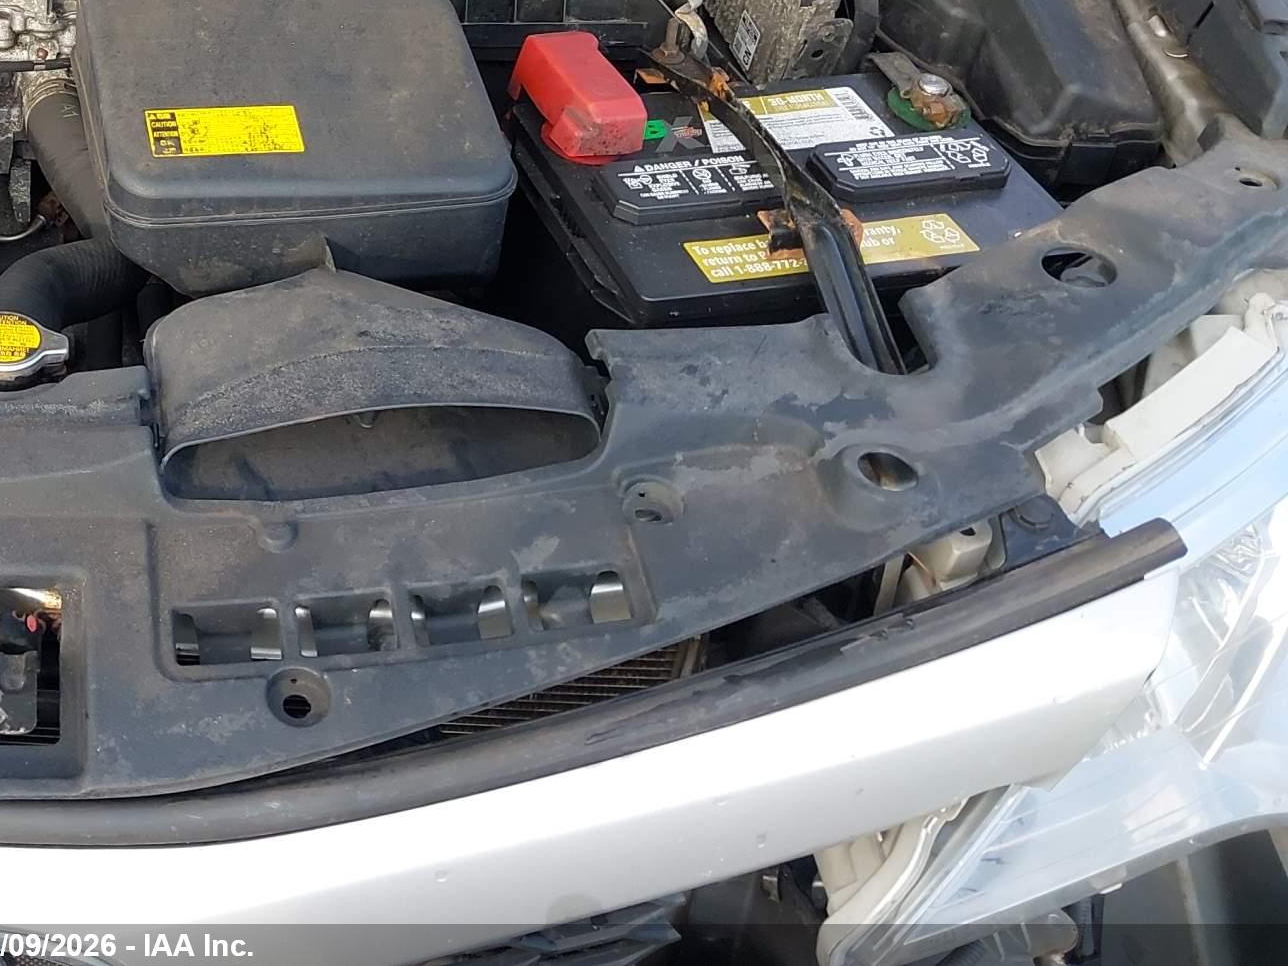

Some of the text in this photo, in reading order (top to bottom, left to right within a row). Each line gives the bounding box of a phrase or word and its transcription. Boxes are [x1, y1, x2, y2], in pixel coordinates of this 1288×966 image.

[644, 160, 693, 172] DANGER
[701, 155, 745, 166] POISON
[691, 245, 710, 256] To
[710, 240, 756, 255] replace
[863, 225, 901, 237] ranty,
[702, 255, 743, 267] return
[743, 252, 757, 262] to
[881, 237, 896, 246] or
[711, 265, 734, 278] call
